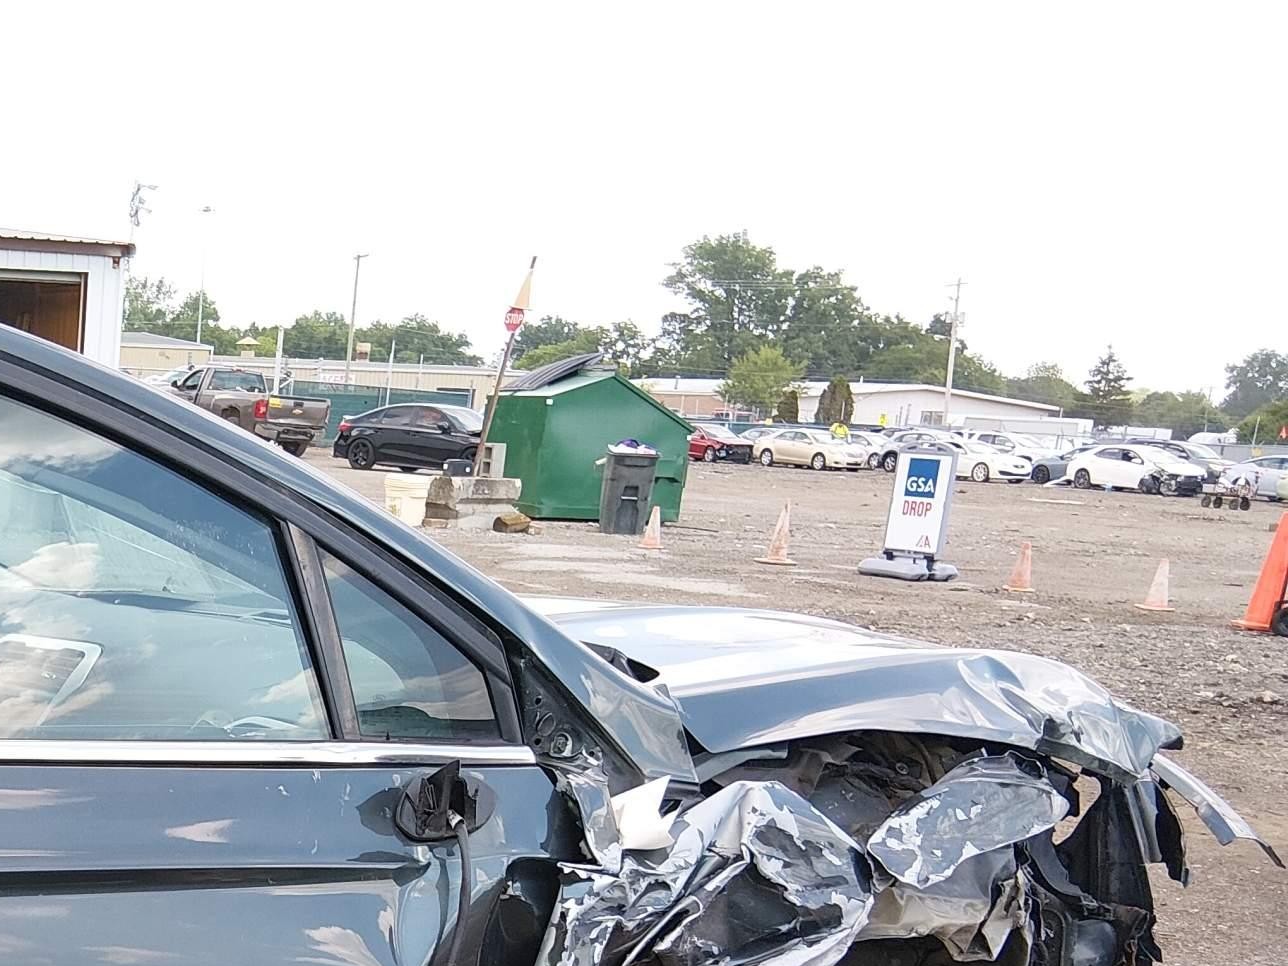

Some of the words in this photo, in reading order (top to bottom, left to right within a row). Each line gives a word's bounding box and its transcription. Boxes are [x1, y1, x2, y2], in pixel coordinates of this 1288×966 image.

[506, 312, 524, 325] STOP
[906, 476, 935, 494] GSA
[902, 500, 933, 518] DROP
